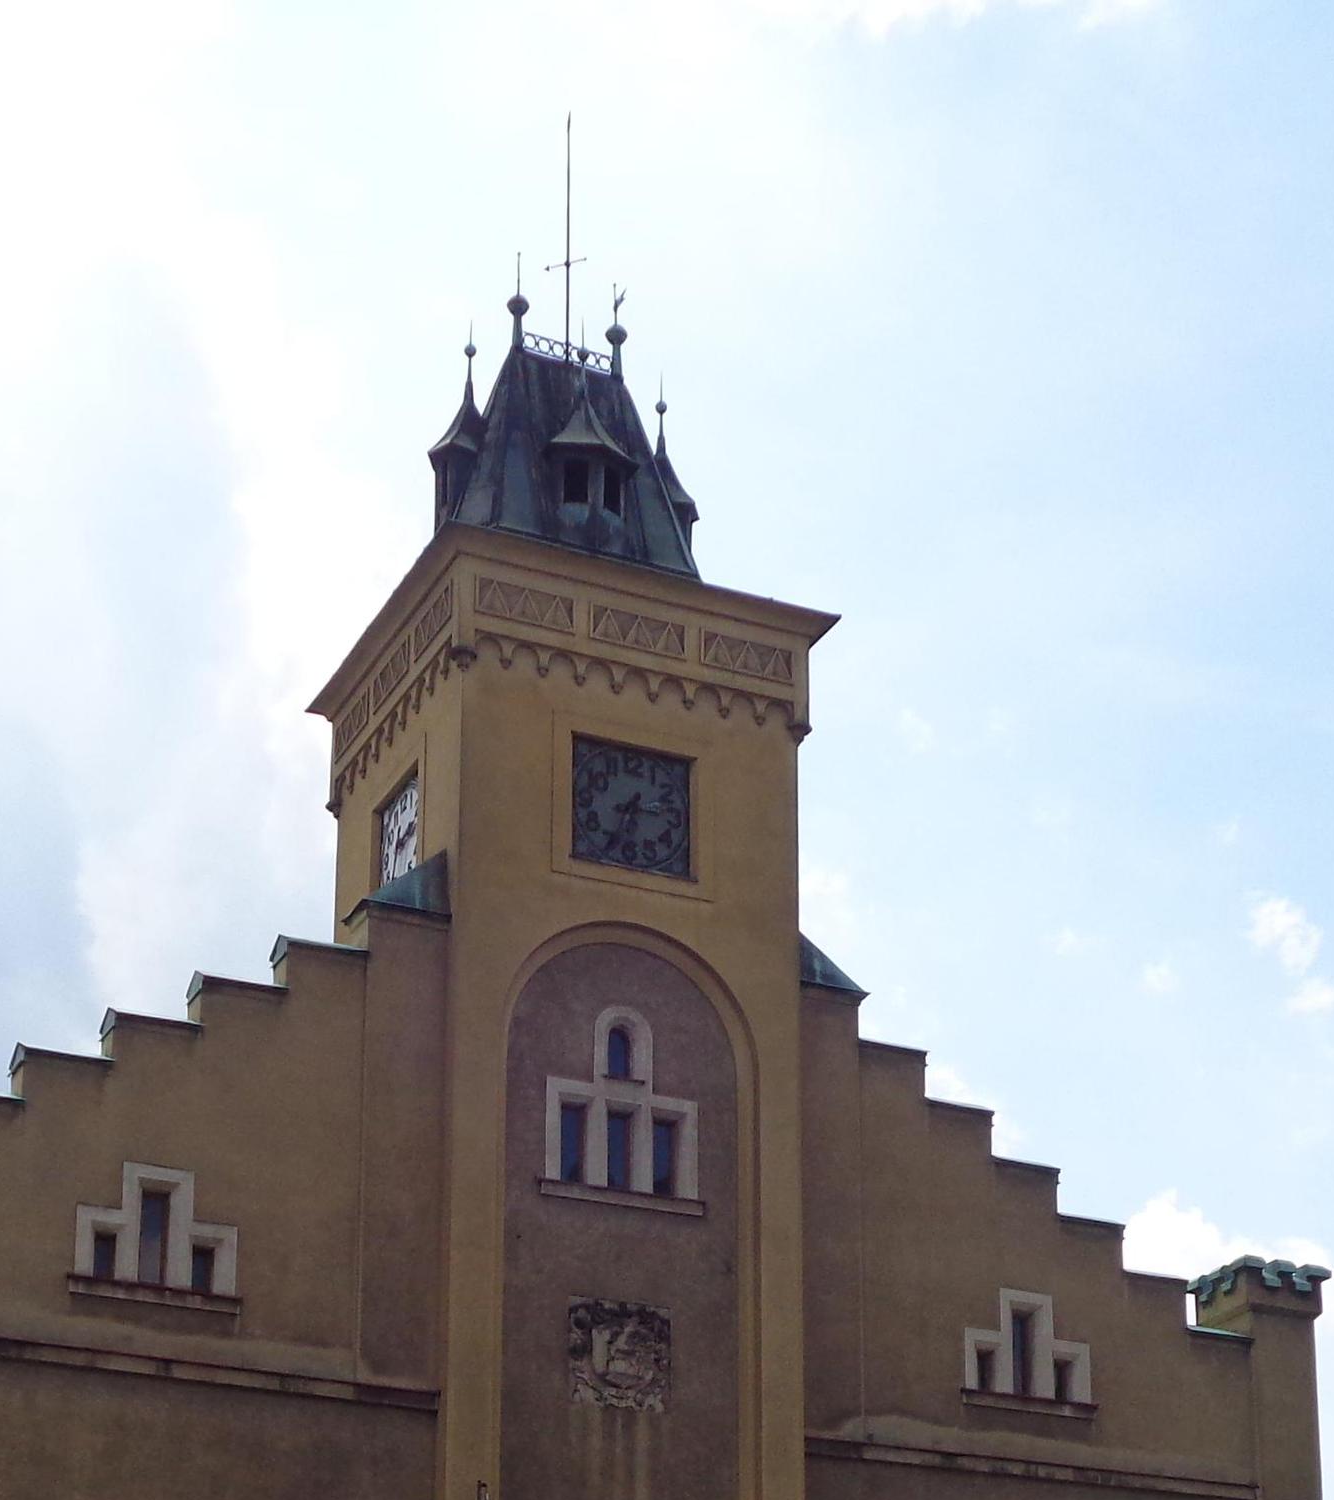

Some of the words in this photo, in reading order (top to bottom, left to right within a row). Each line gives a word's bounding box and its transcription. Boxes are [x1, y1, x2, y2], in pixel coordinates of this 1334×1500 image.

[622, 752, 645, 779] 12
[587, 770, 610, 793] 10
[585, 810, 601, 832] 8
[667, 806, 682, 830] 3
[641, 838, 658, 862] 5
[658, 828, 673, 849] 4
[621, 840, 638, 862] 6
